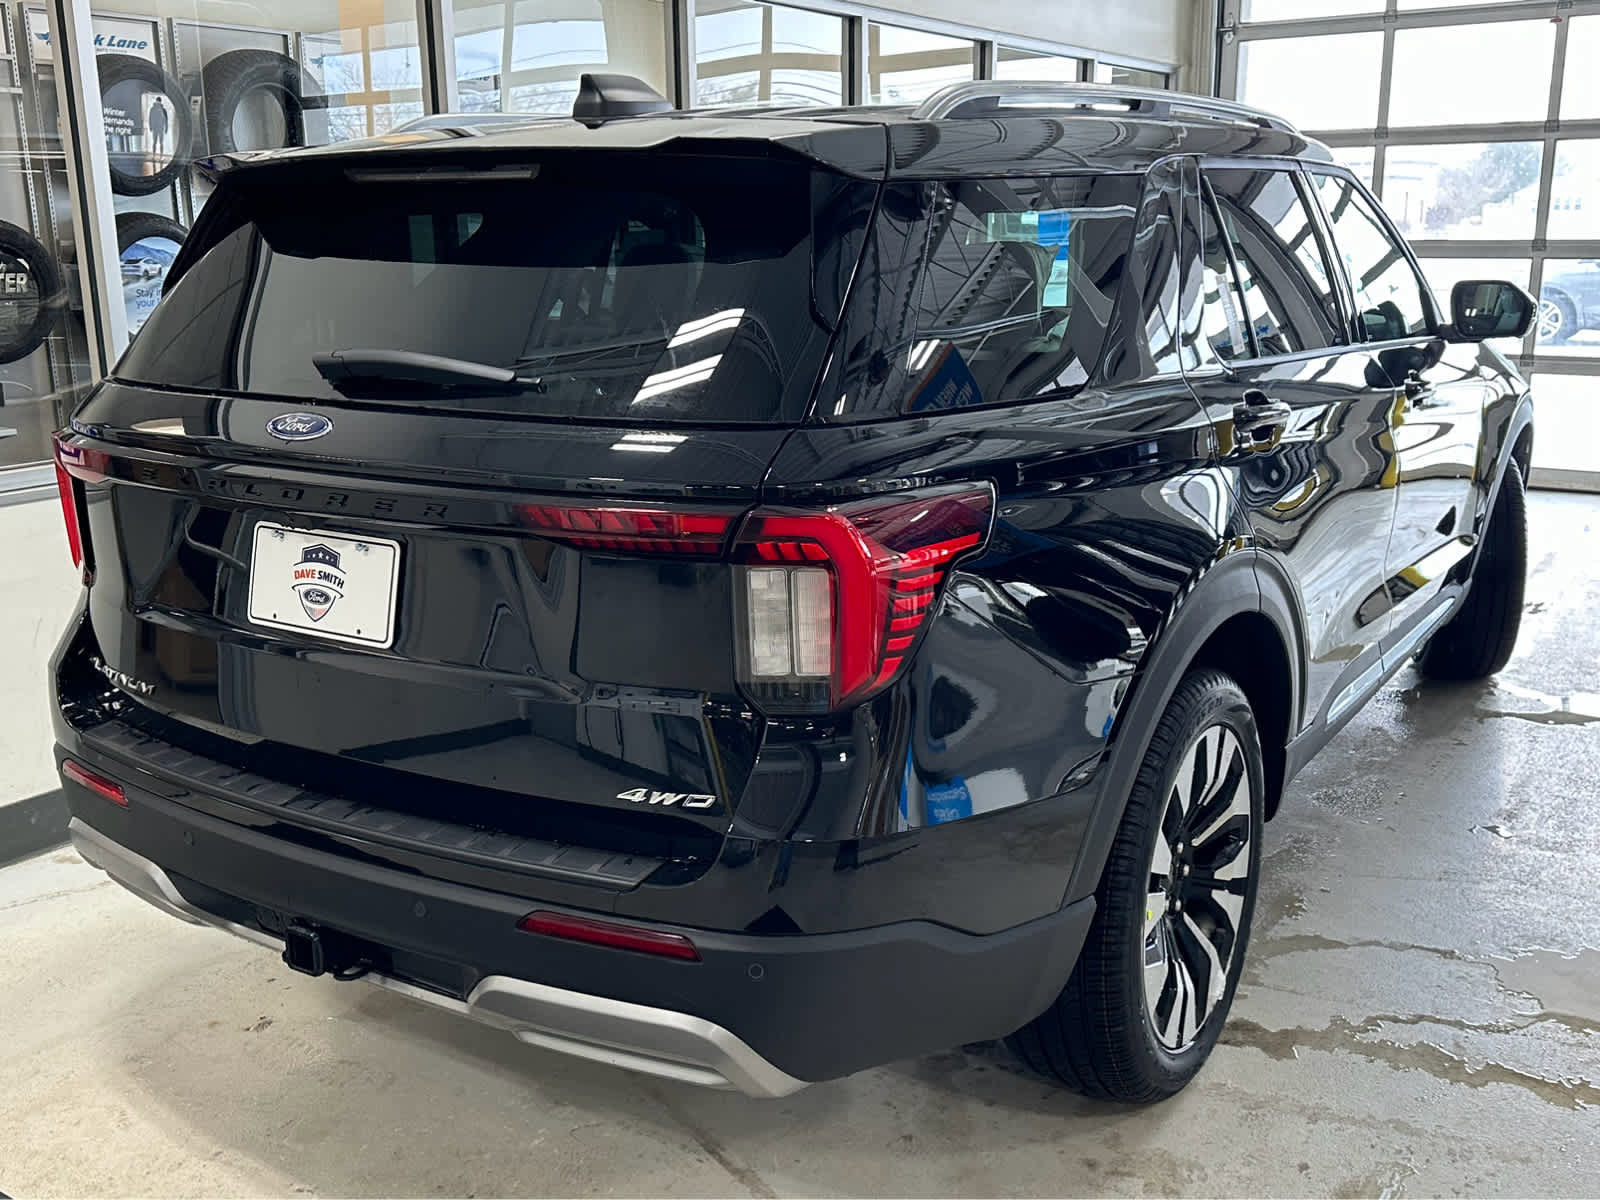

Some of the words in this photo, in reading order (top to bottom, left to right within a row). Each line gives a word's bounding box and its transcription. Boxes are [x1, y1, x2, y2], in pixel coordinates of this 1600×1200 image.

[107, 35, 148, 49] Lane
[103, 107, 126, 117] Winter
[103, 116, 135, 126] demands
[136, 289, 153, 298] Stay
[136, 300, 155, 309] your
[143, 467, 448, 519] EXPLORER
[294, 568, 317, 580] DAVE
[317, 570, 345, 589] SMITH
[616, 788, 716, 808] 4WD
